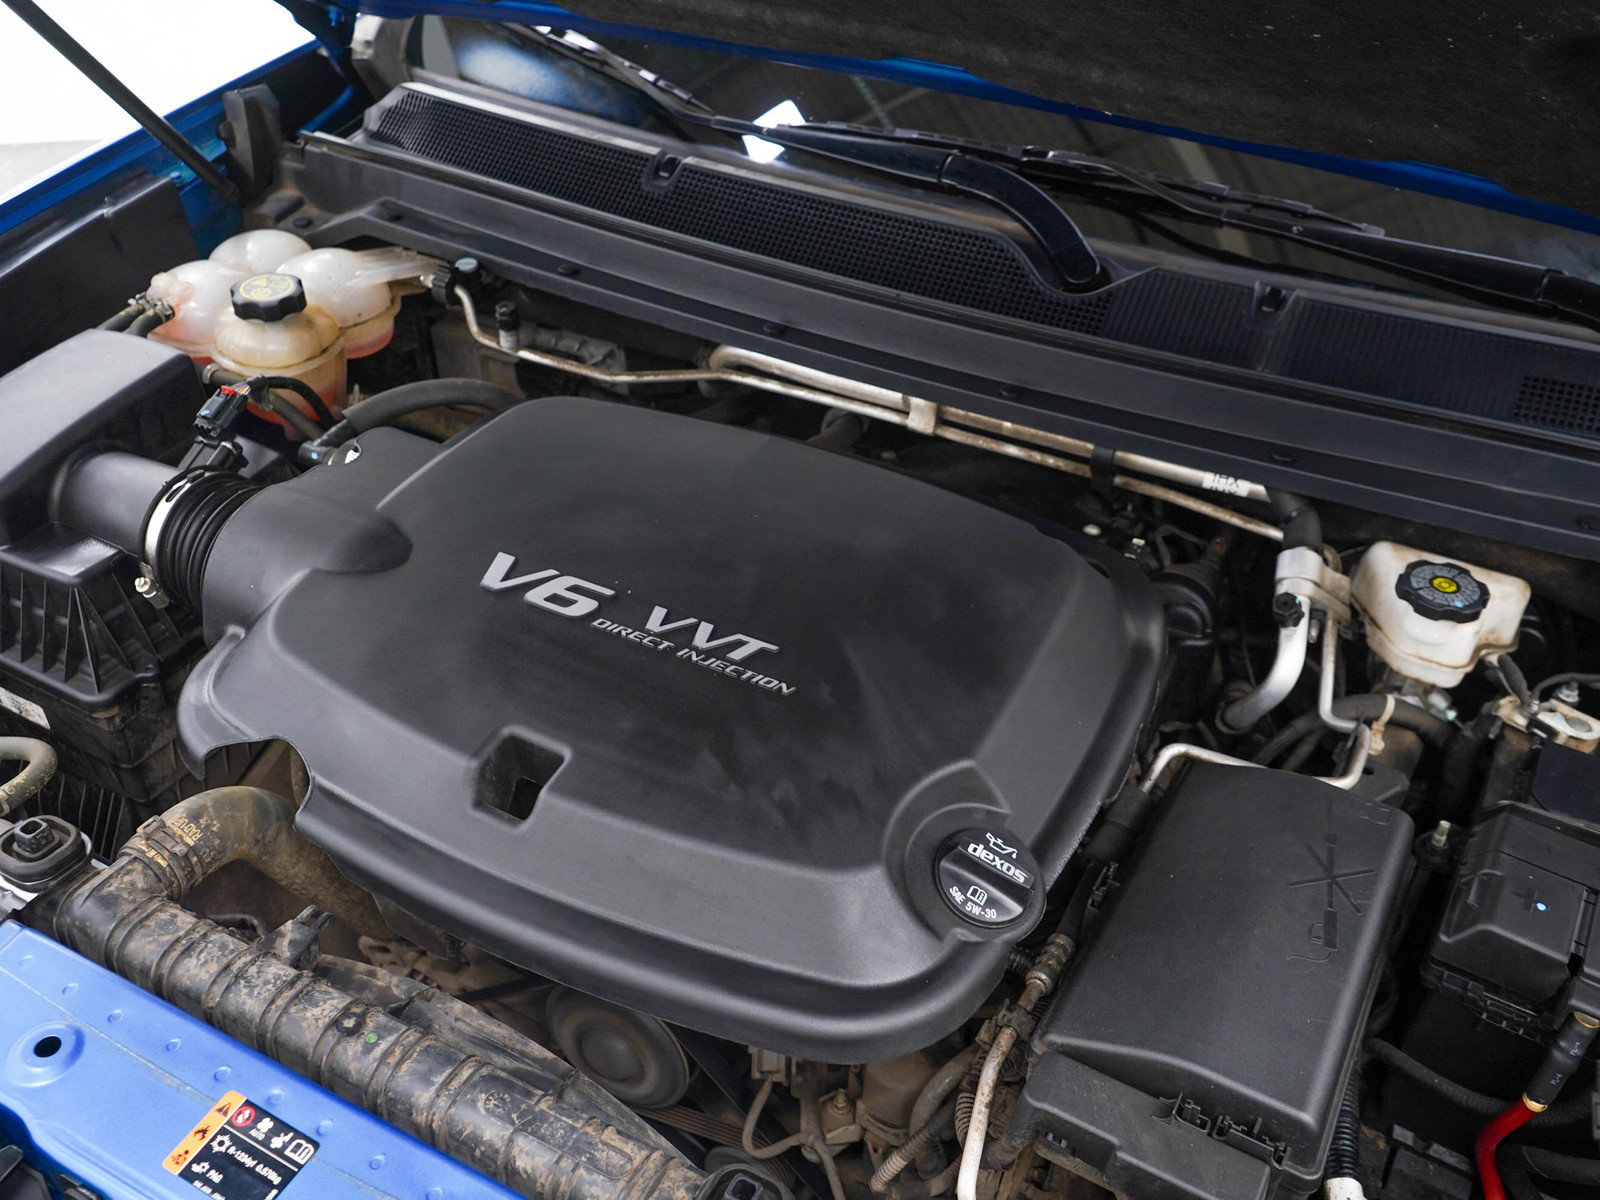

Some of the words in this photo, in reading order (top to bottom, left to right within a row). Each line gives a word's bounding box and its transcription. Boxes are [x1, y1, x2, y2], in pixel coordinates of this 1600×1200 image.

[480, 551, 616, 618] V6
[591, 617, 675, 651] DIRECT
[676, 648, 798, 696] INJECTION
[645, 605, 780, 662] VVT
[967, 842, 1028, 883] dexos
[949, 885, 966, 905] SAE
[965, 901, 997, 919] 5W-30
[249, 1128, 266, 1141] AUTO
